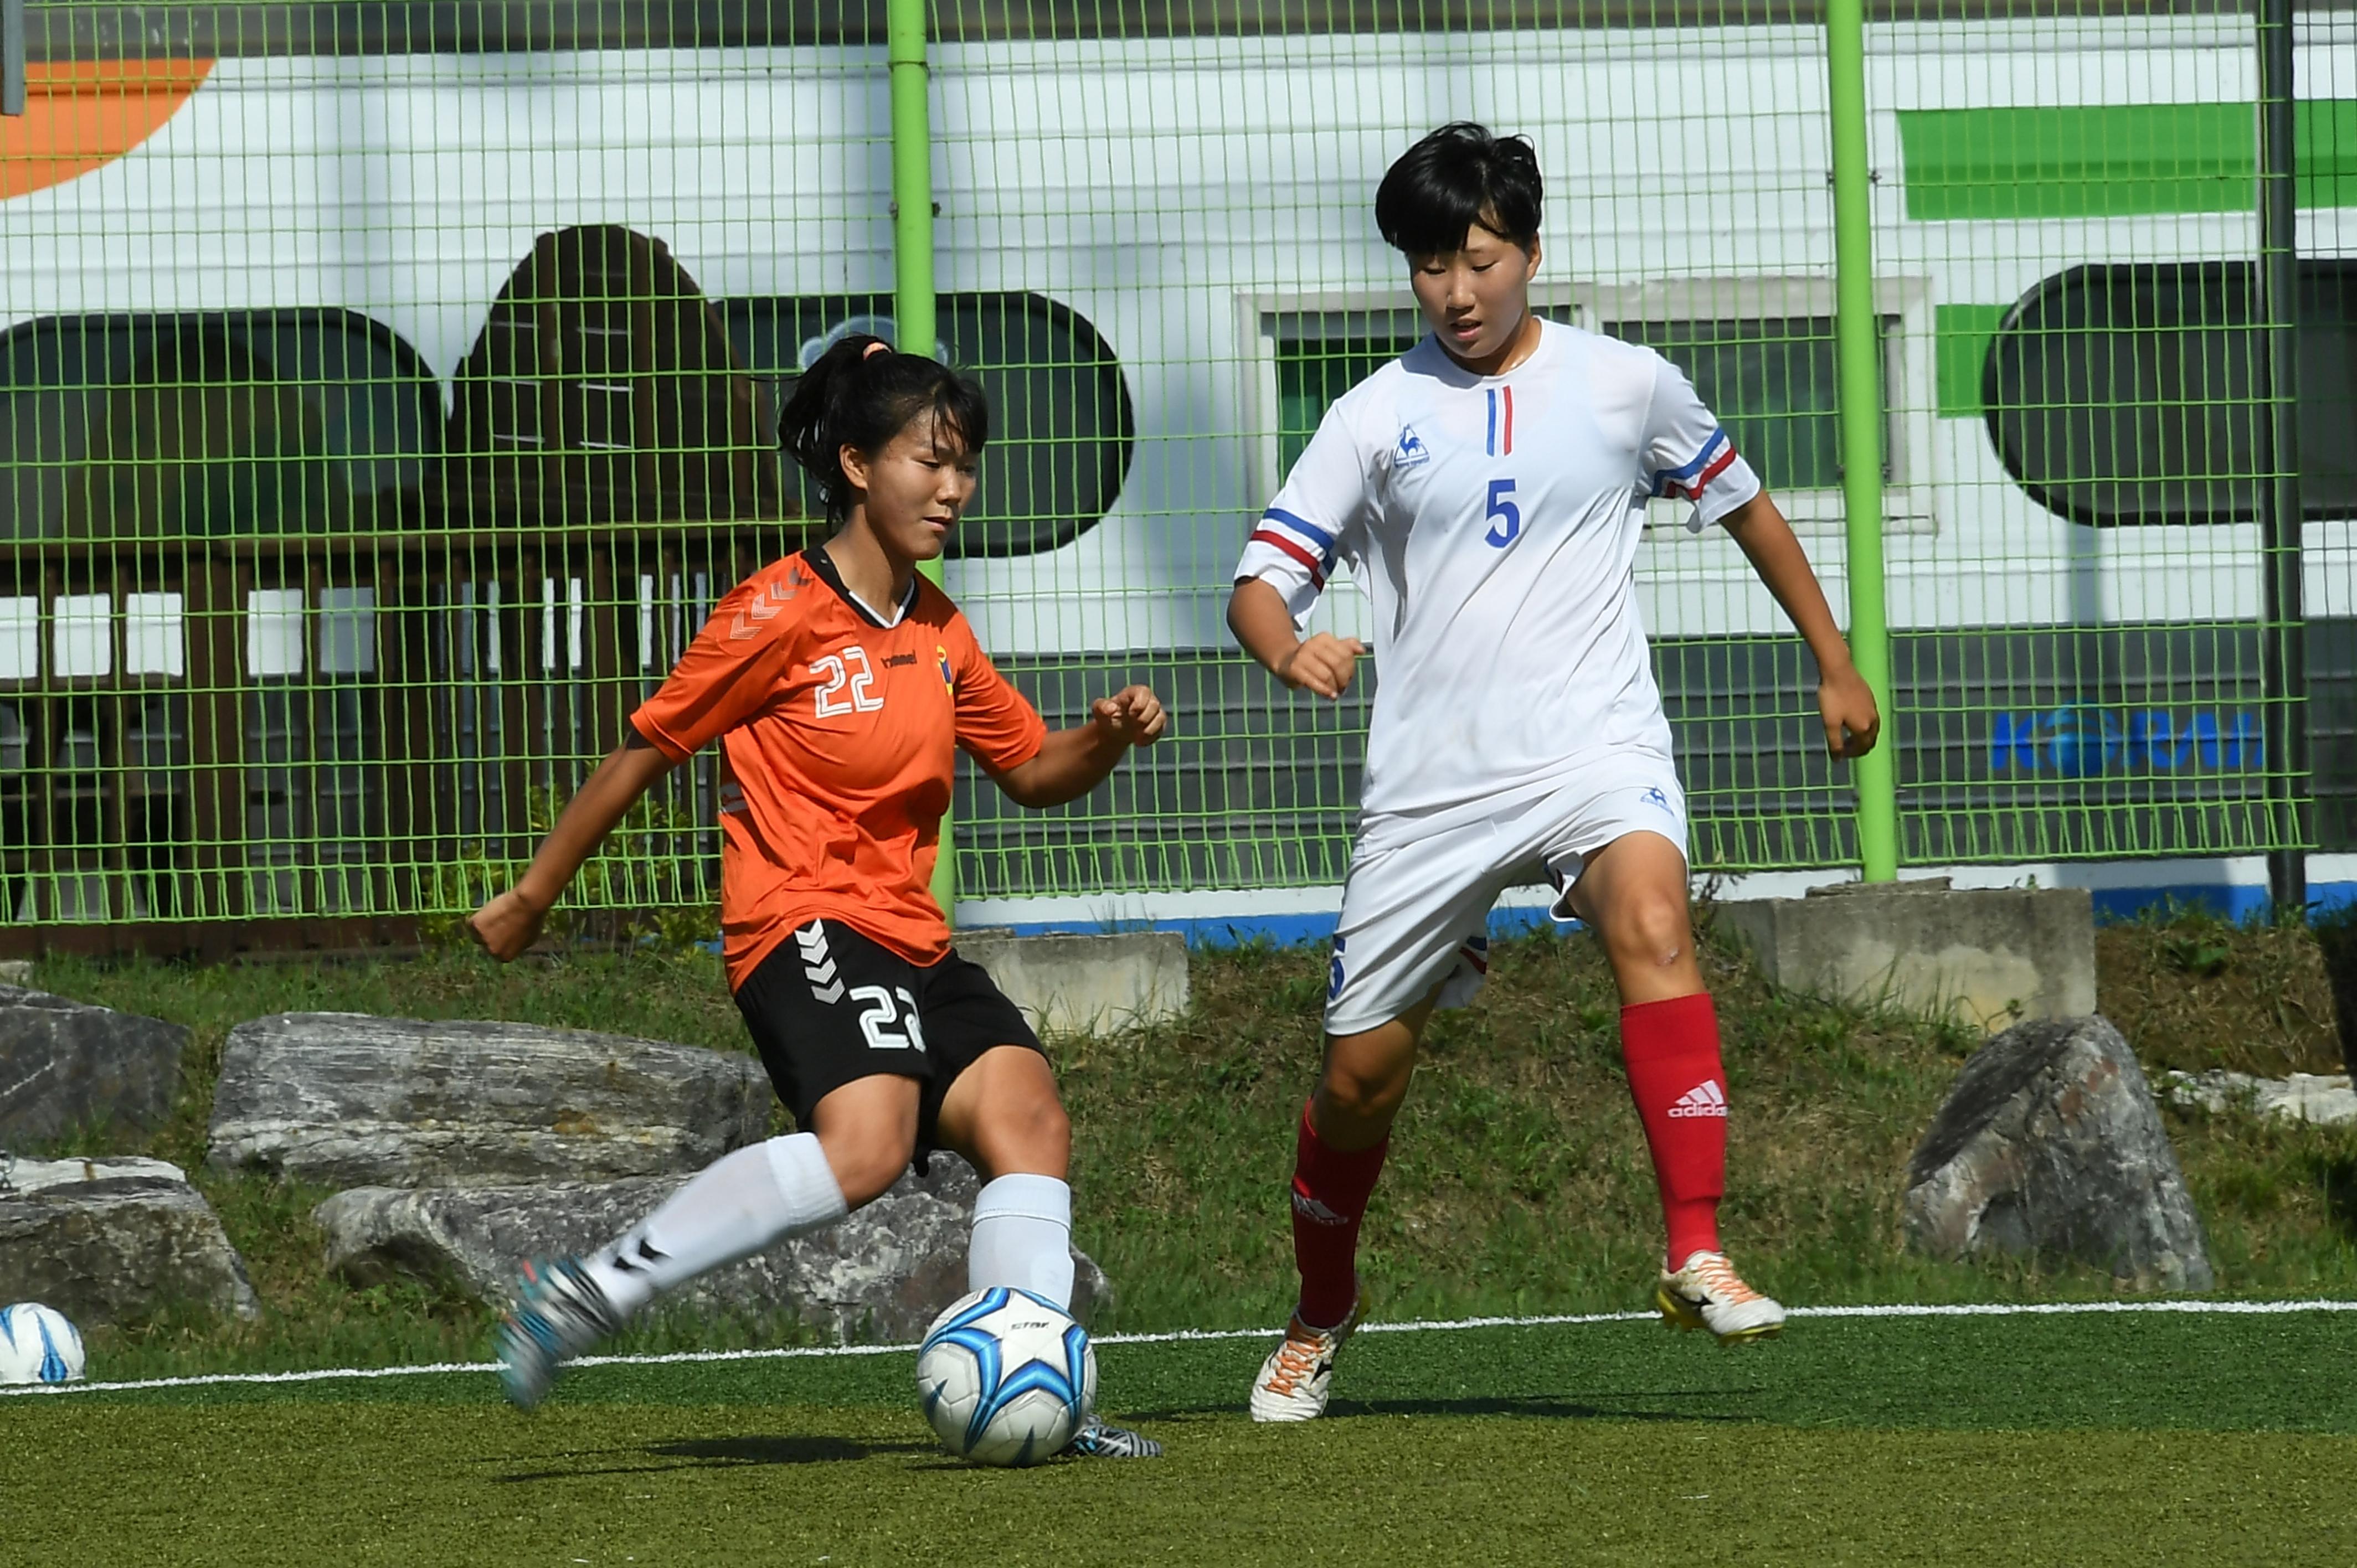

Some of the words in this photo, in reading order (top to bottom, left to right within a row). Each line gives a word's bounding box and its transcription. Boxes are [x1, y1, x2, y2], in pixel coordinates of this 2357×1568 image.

[1485, 479, 1520, 548] 5
[809, 646, 884, 719] 22
[1991, 700, 2266, 774] KORAI
